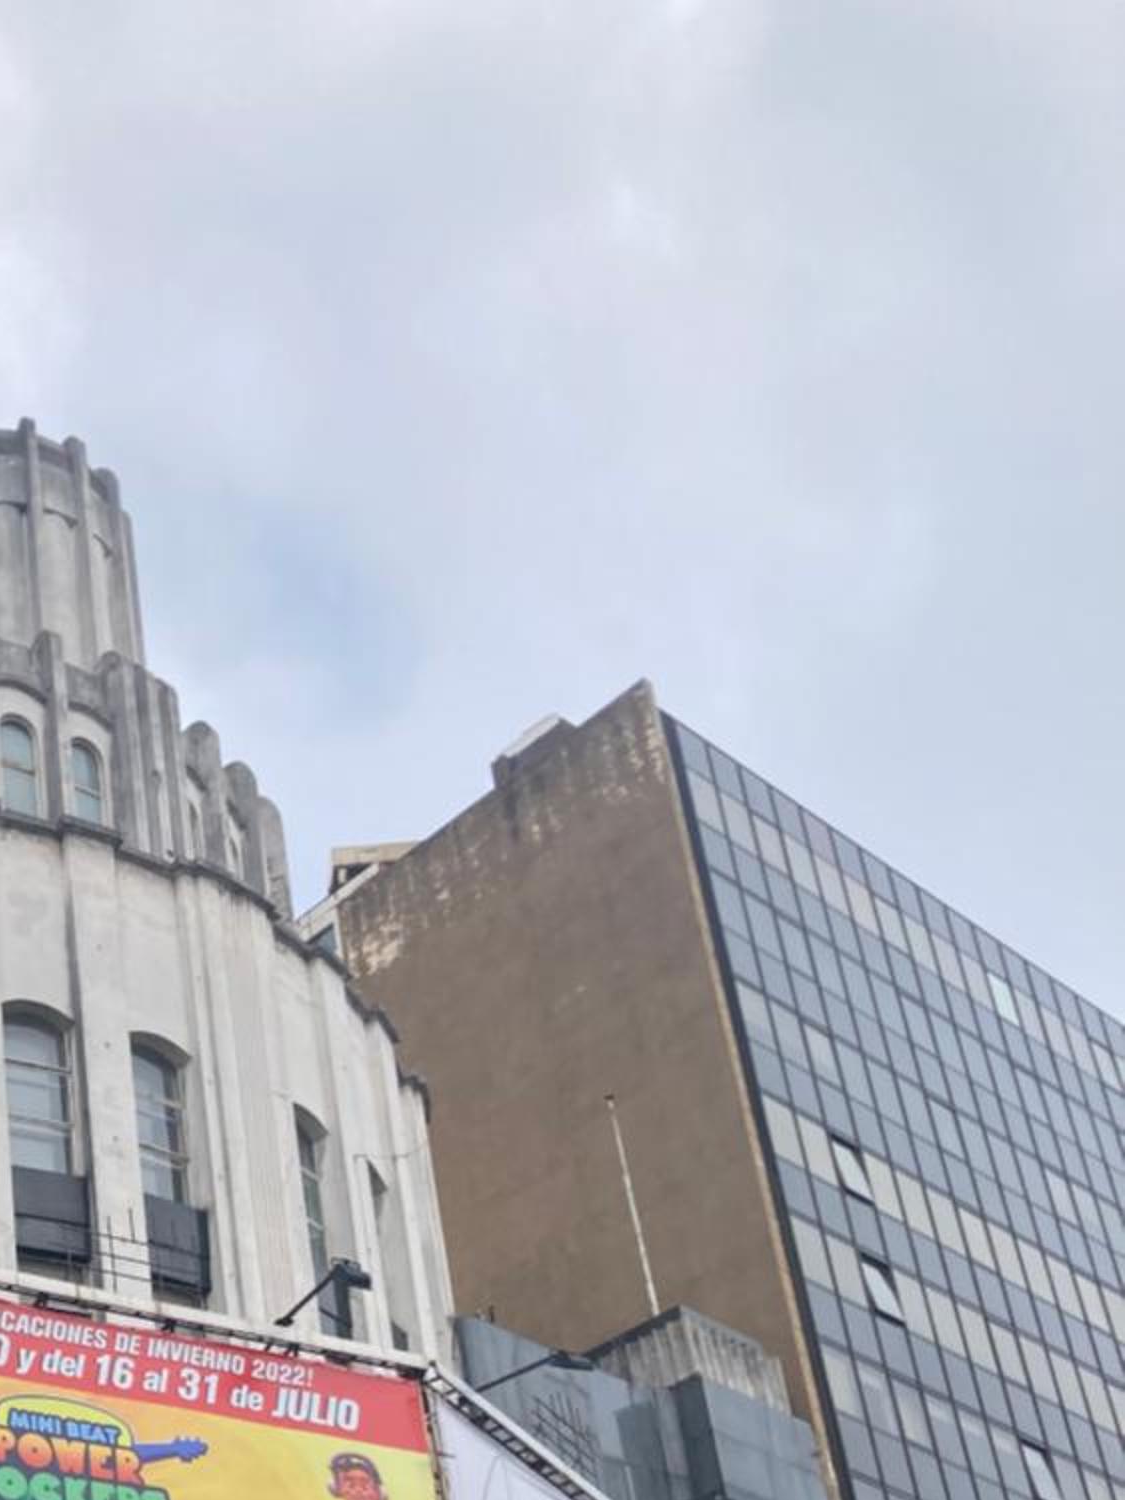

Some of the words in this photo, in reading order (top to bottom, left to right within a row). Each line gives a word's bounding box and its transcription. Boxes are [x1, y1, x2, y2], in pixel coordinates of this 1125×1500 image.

[114, 1332, 141, 1356] DE
[148, 1338, 245, 1376] INVIERNO
[251, 1359, 315, 1387] 2022!
[16, 1349, 36, 1374] y
[41, 1349, 86, 1378] del
[97, 1354, 135, 1390] 16
[143, 1369, 169, 1393] al
[178, 1369, 220, 1405] 31
[230, 1385, 264, 1412] de
[272, 1388, 361, 1432] JULIO
[9, 1409, 62, 1435] MINI
[66, 1422, 120, 1445] BEAT
